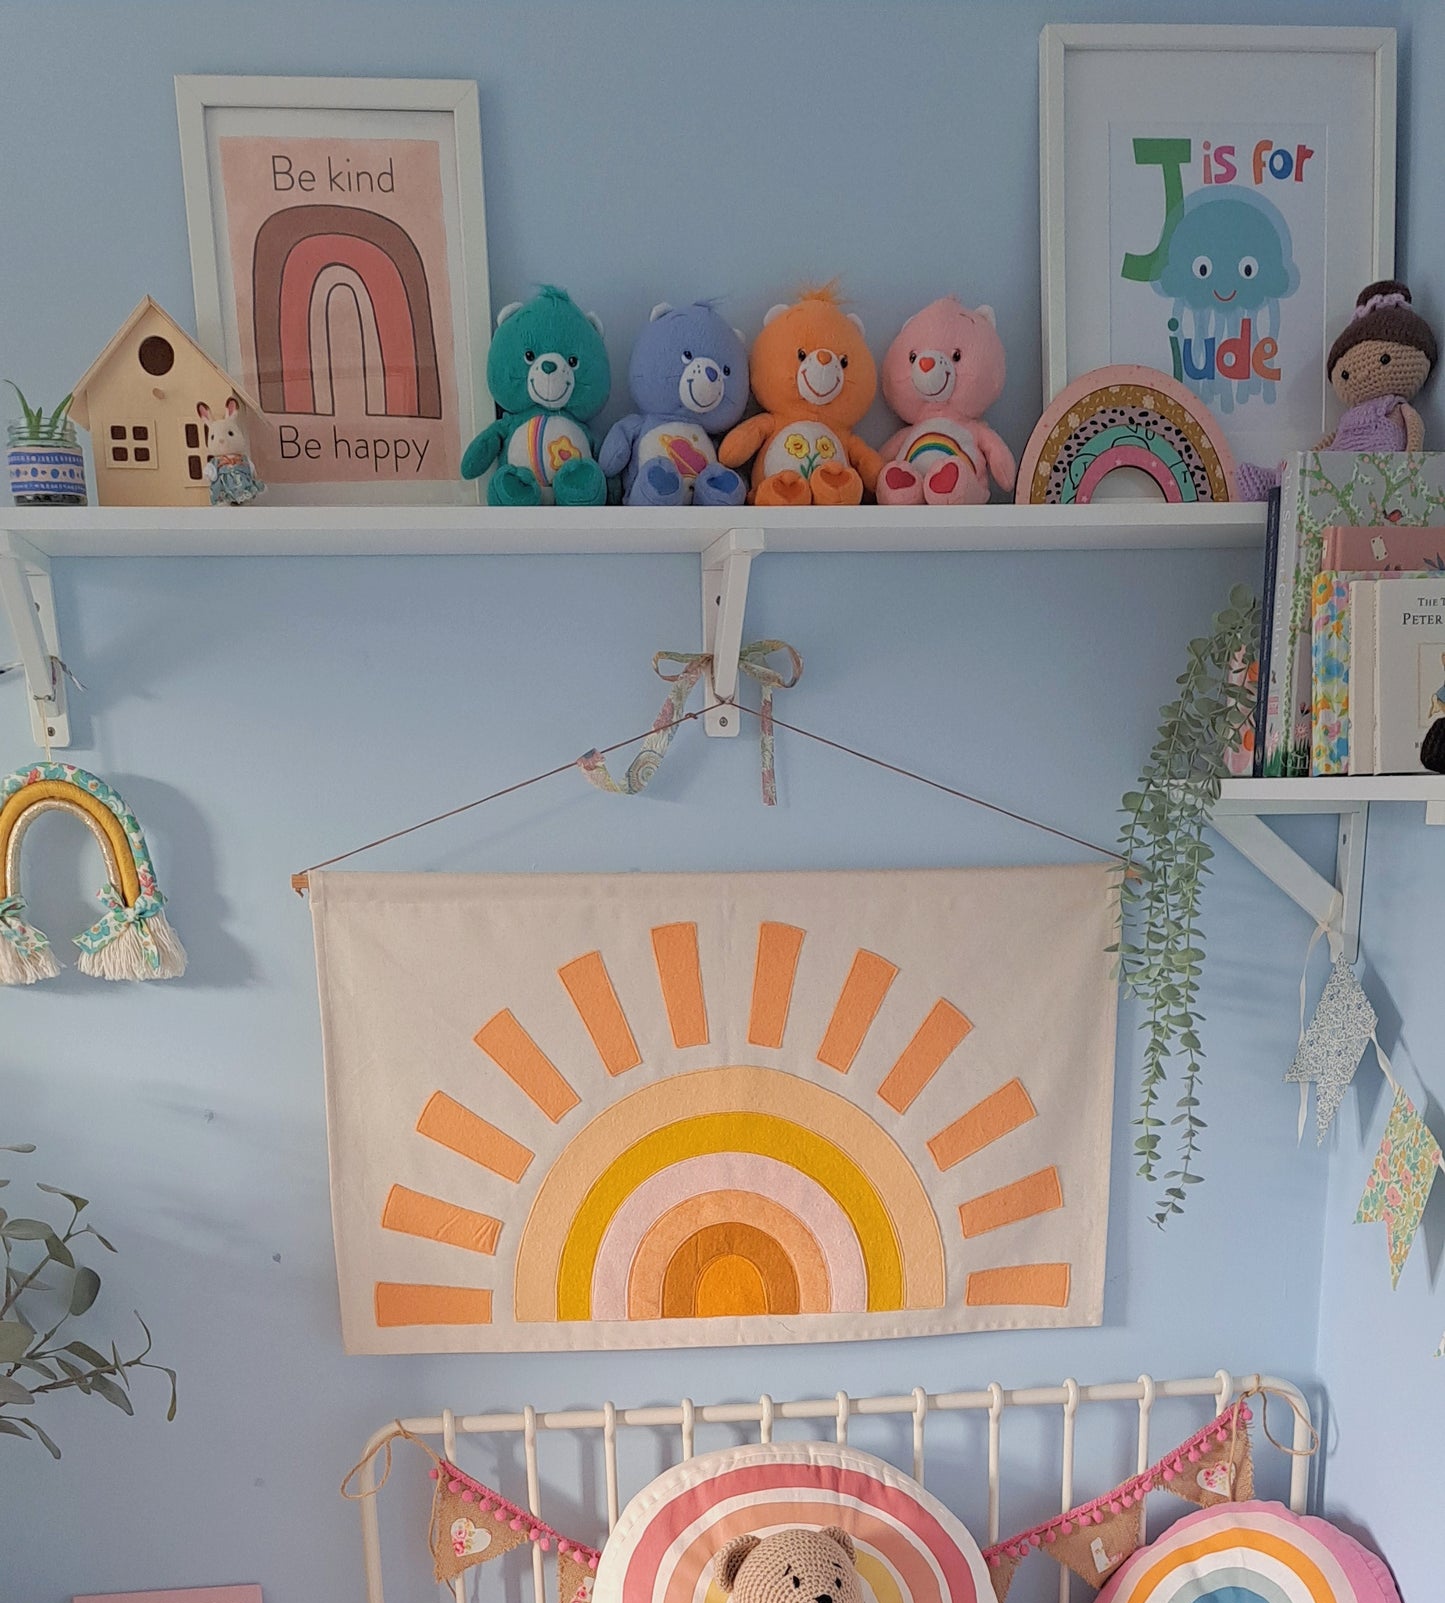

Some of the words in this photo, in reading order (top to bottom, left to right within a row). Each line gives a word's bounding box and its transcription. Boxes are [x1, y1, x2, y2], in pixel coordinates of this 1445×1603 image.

[272, 155, 316, 192] Be
[328, 155, 395, 193] kind
[1121, 138, 1191, 282] J
[1203, 140, 1238, 184] is
[1252, 139, 1315, 185] for
[1167, 318, 1282, 384] jude
[279, 425, 322, 460] Be
[333, 425, 430, 473] happy
[1280, 510, 1291, 573] Secret
[1273, 583, 1286, 657] Garden
[1402, 612, 1443, 625] PETER
